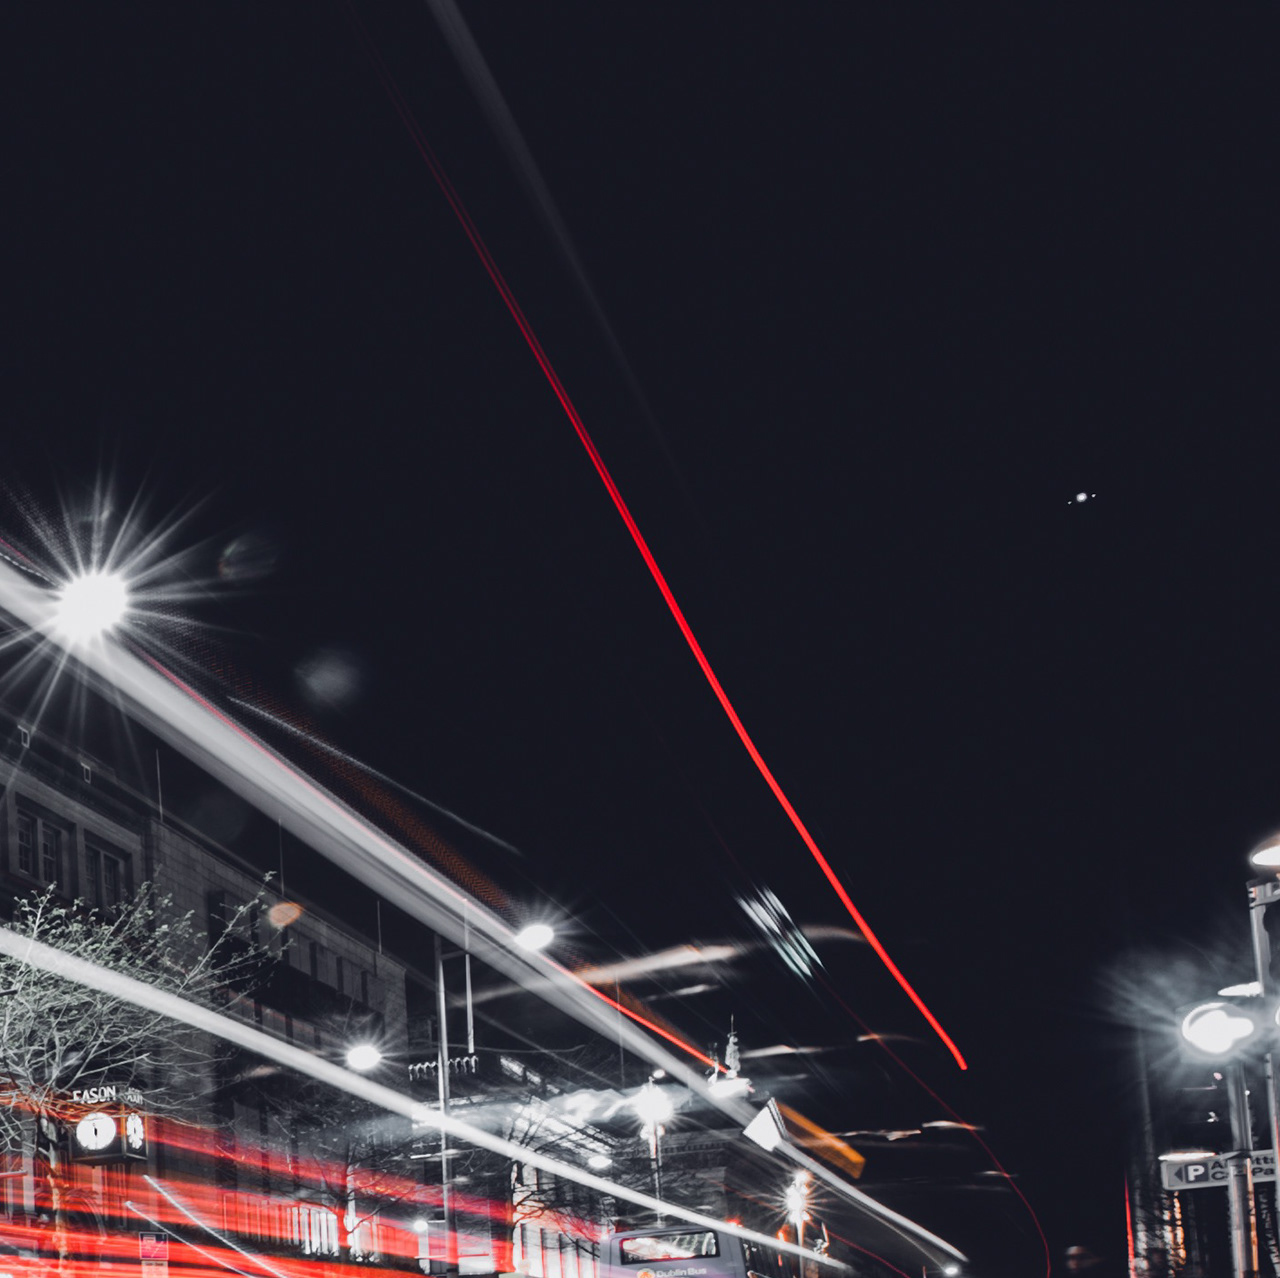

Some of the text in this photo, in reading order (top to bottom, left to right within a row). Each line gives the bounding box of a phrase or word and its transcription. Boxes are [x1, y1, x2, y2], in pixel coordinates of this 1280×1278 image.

[73, 1086, 117, 1104] EASON
[1187, 1165, 1205, 1181] P
[656, 1267, 707, 1278] Dublin Bus
